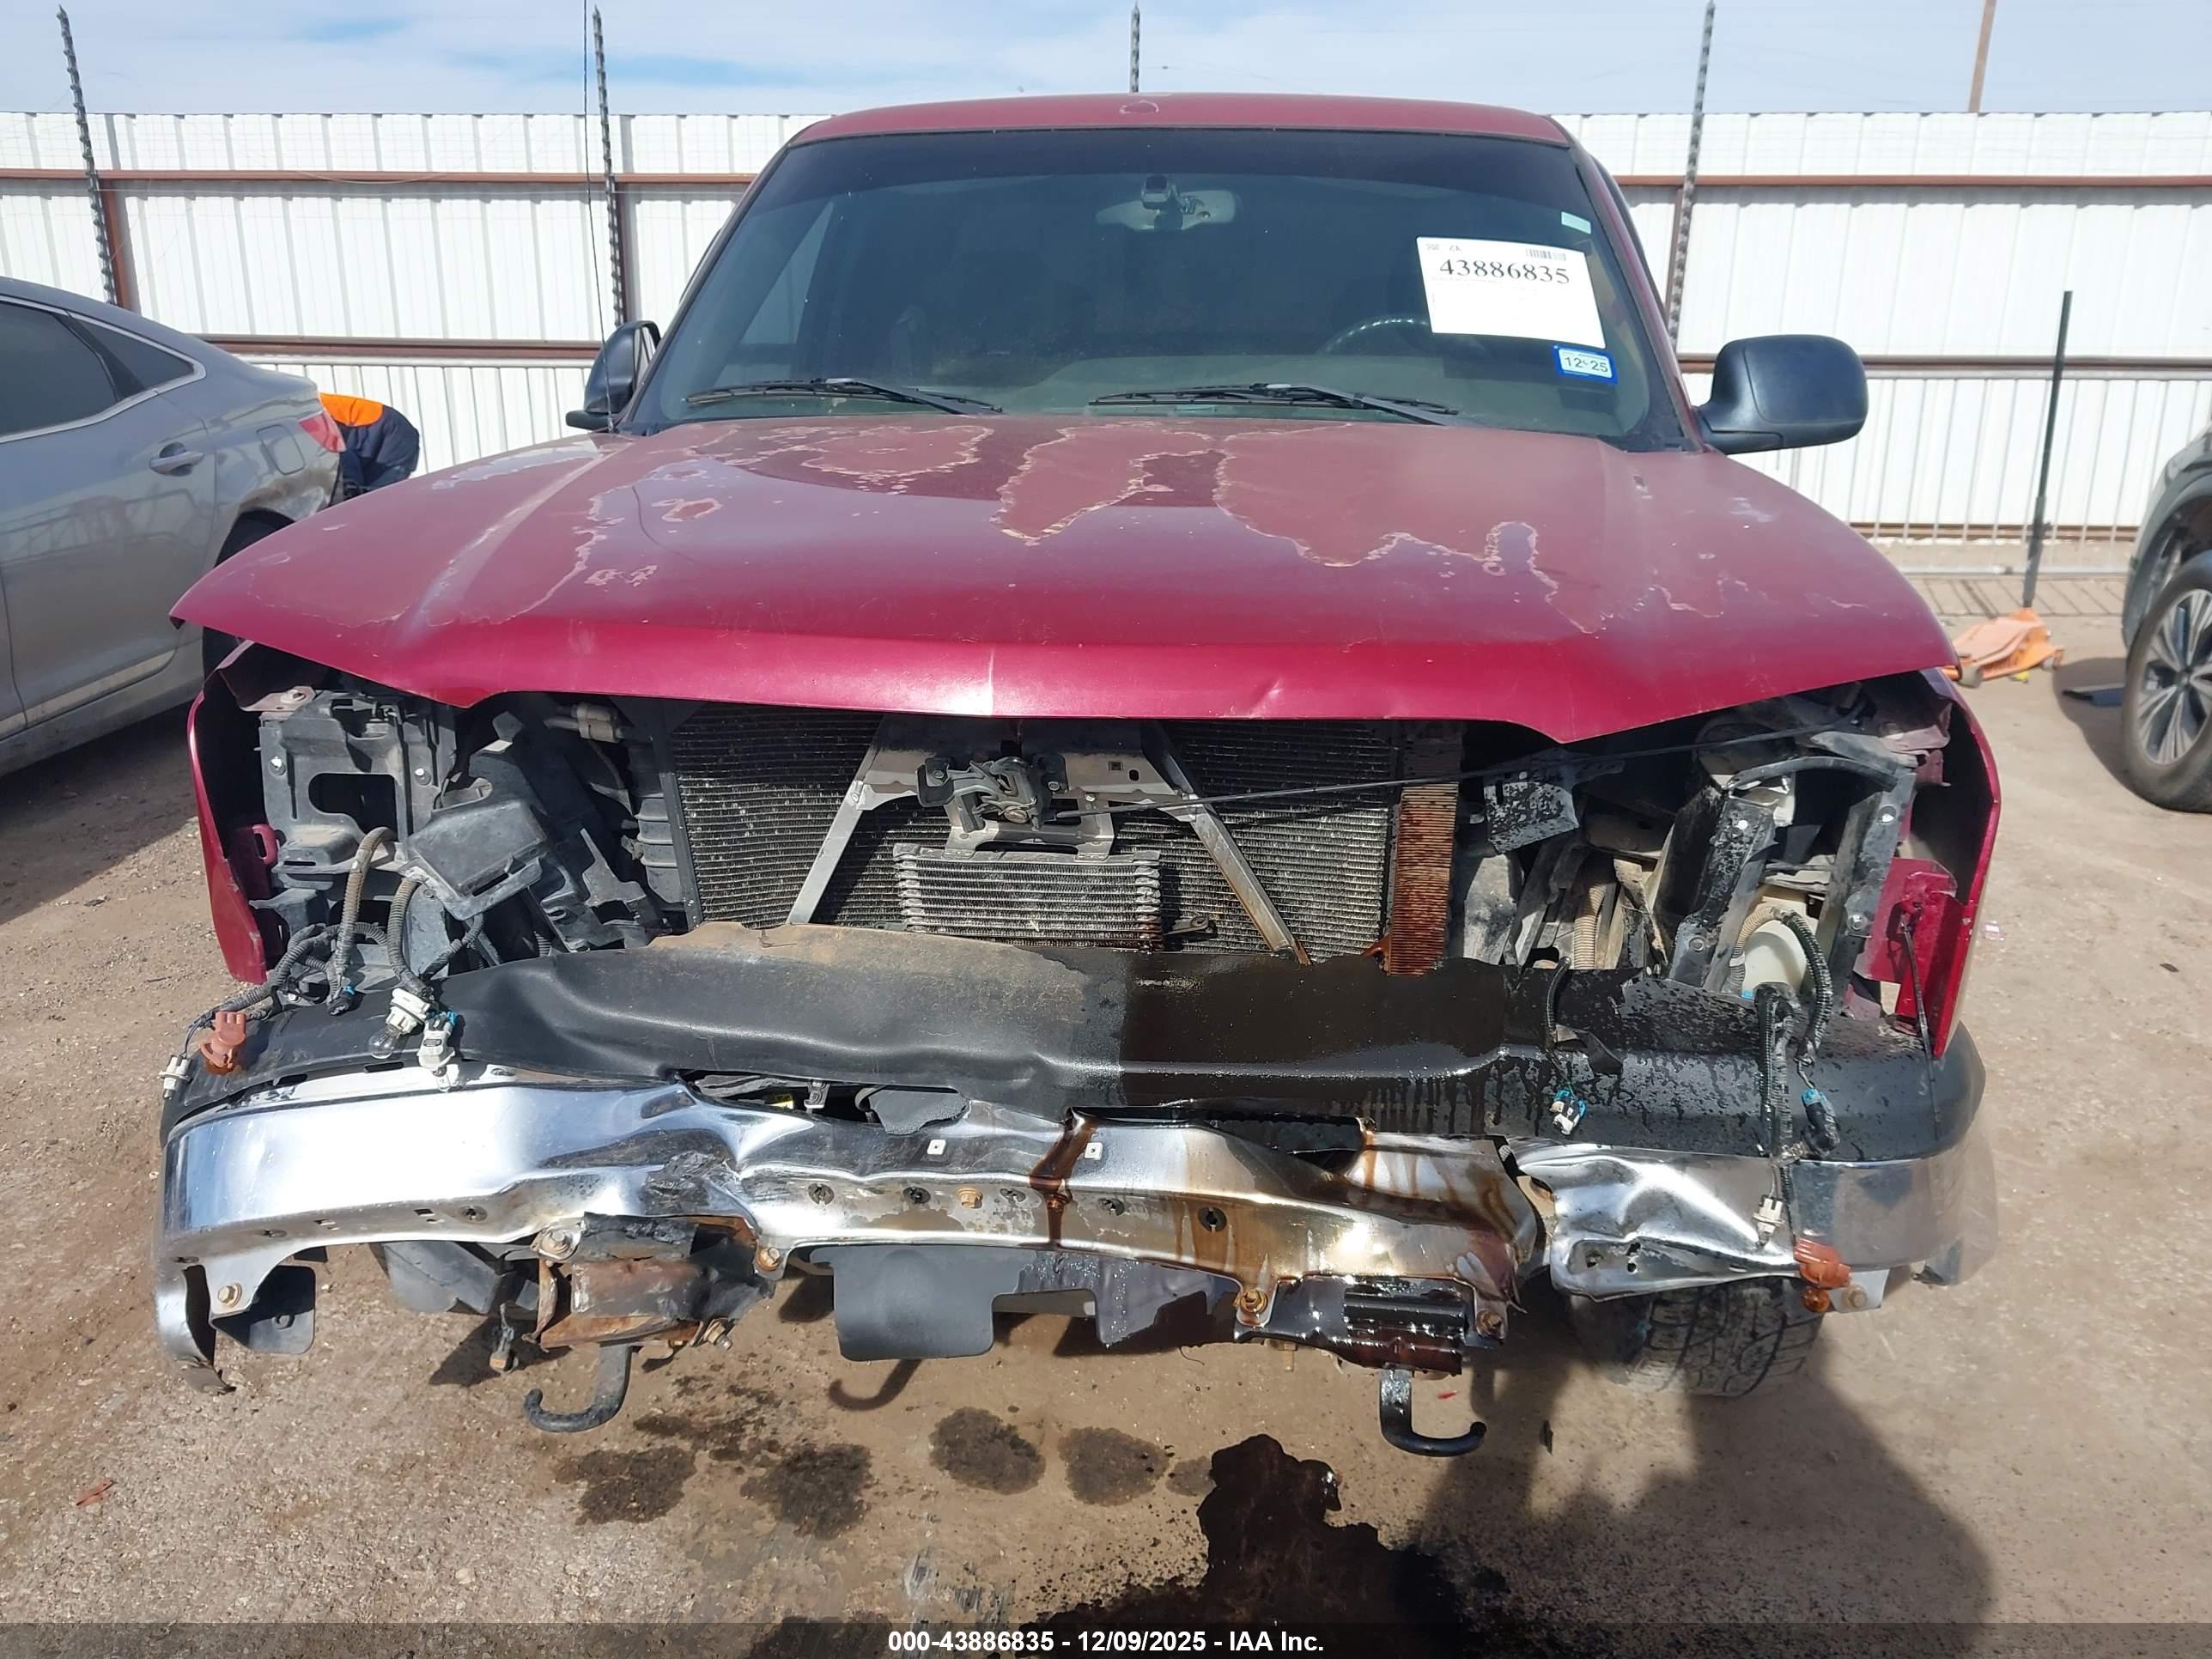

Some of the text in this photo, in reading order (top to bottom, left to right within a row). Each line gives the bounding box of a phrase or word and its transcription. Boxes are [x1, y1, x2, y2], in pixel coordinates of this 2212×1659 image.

[1439, 258, 1570, 284] 43886835
[1564, 356, 1608, 373] 12 25
